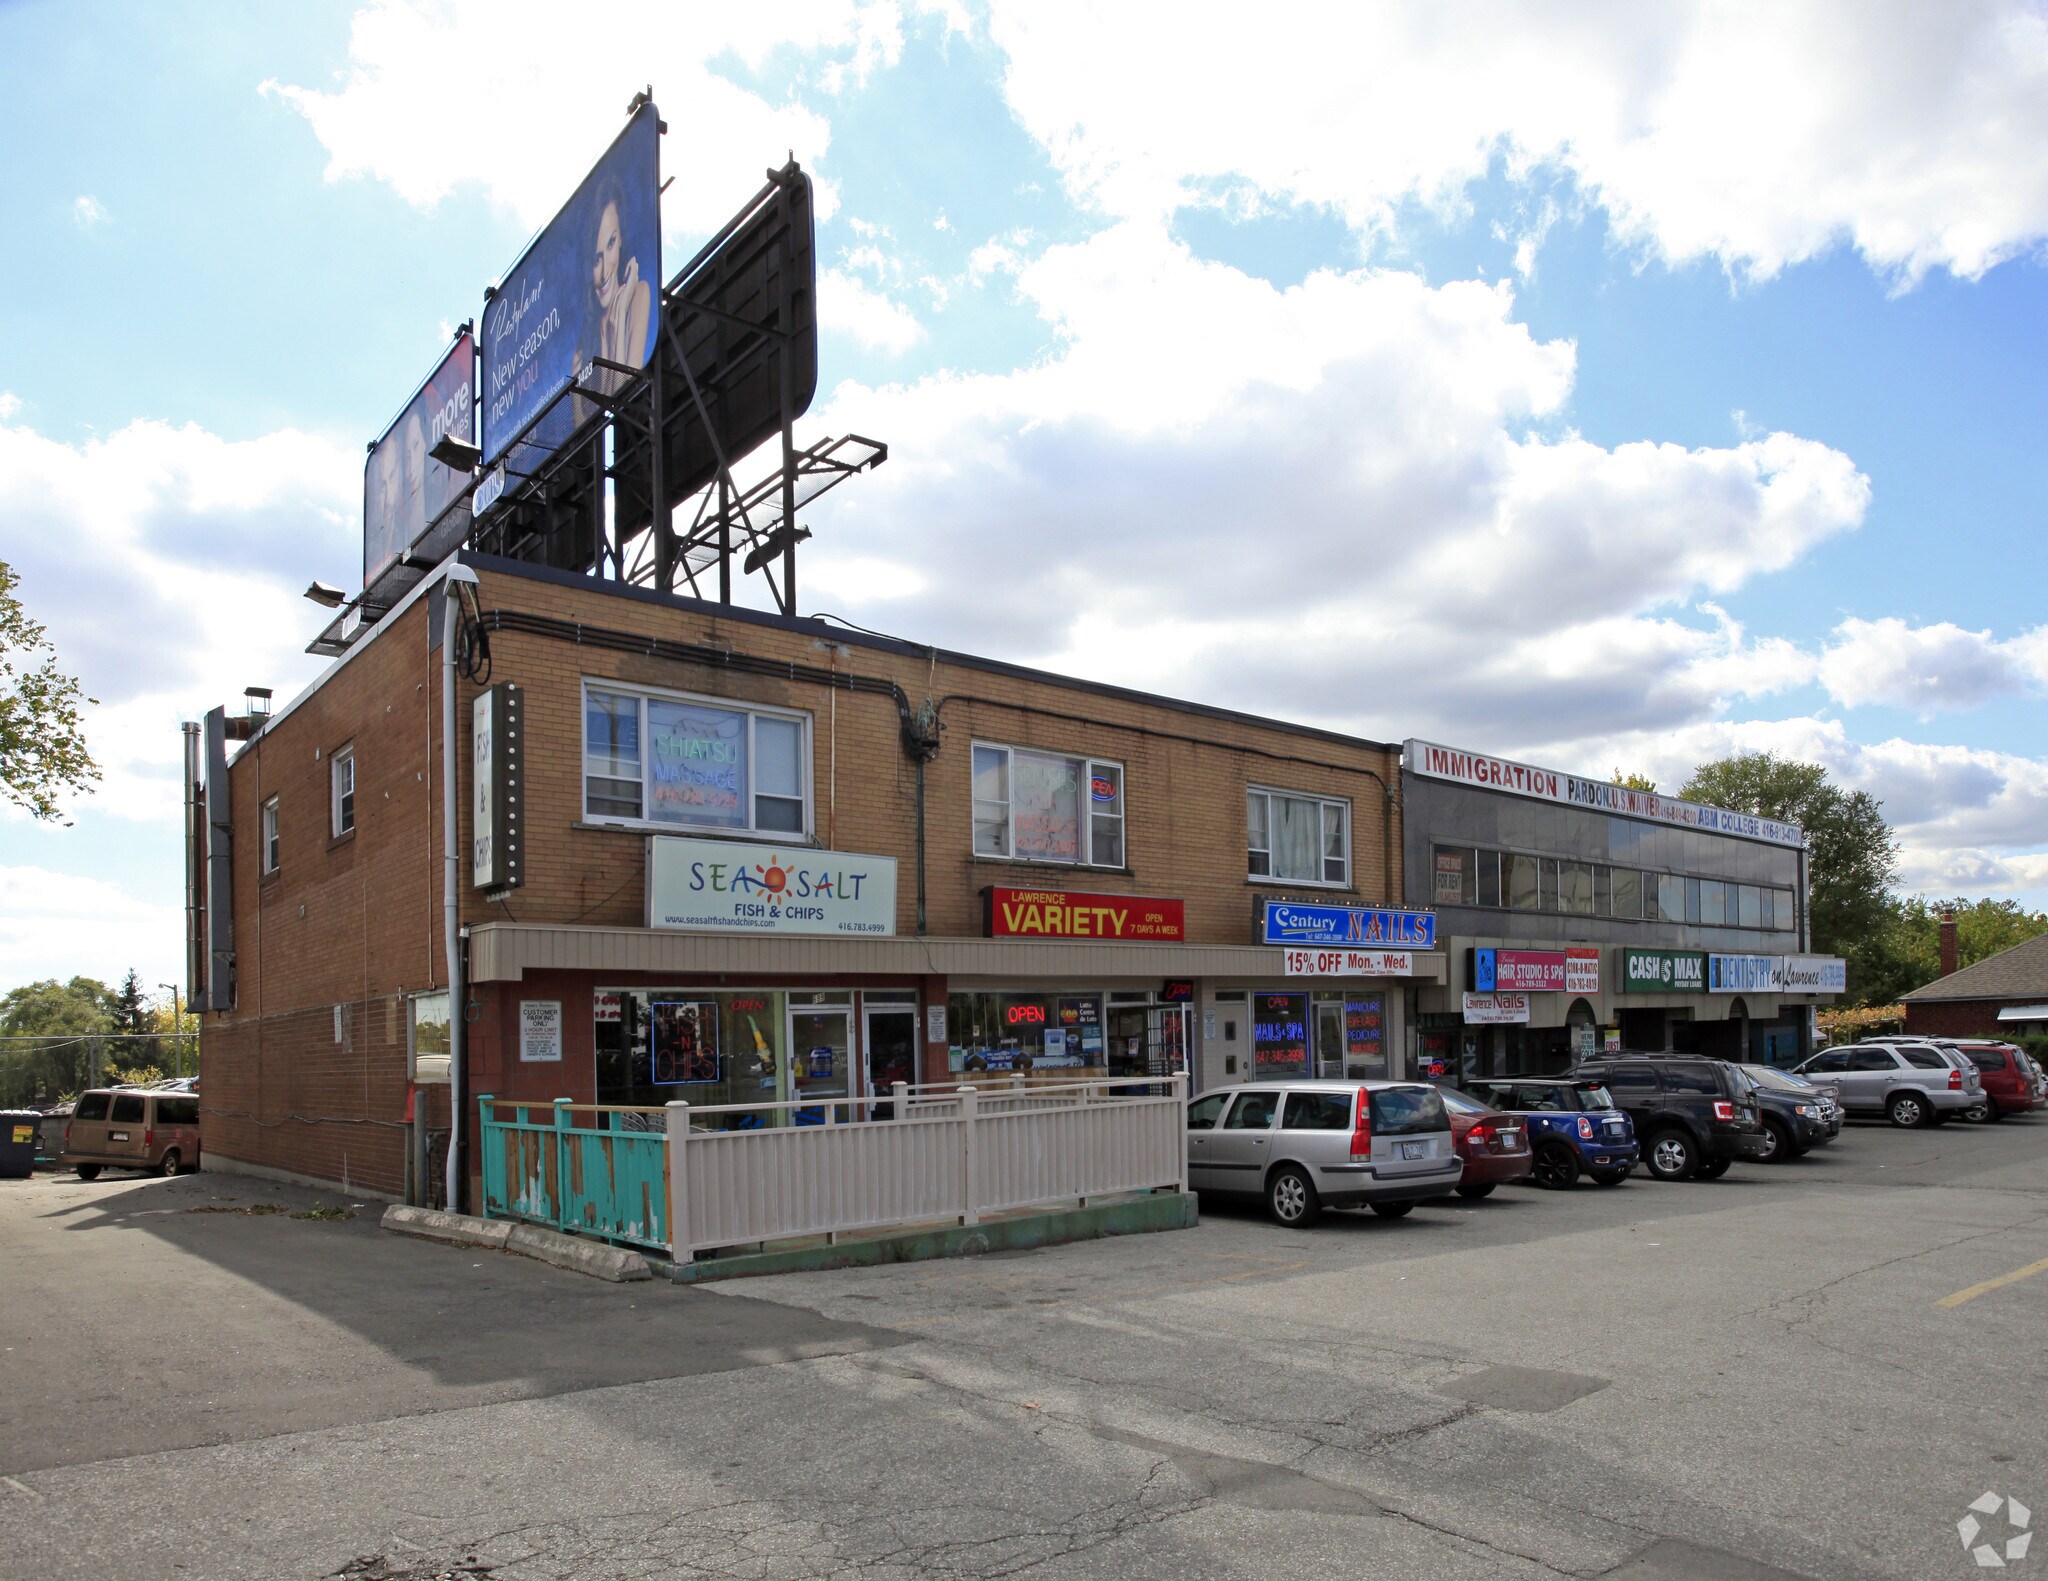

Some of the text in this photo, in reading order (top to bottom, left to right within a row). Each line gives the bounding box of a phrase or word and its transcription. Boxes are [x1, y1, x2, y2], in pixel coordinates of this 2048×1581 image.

[492, 307, 560, 397] New season,
[577, 361, 593, 386] 1423
[492, 360, 539, 425] new you
[432, 382, 469, 442] more
[476, 728, 490, 765] FISH
[656, 734, 737, 764] SHIATSU
[656, 764, 736, 789] MASSAGE
[479, 783, 486, 814] &
[1424, 746, 1557, 797] IMMIGRATION
[1698, 808, 1718, 828] ABM
[1721, 813, 1759, 836] COLLEGE
[475, 836, 492, 870] CHIPS
[689, 861, 867, 900] SEA SALT
[1437, 873, 1461, 890] FOR RENT
[1011, 891, 1066, 904] LAWRENCE
[734, 903, 824, 920] FISH & CHIPS
[1002, 902, 1128, 936] VARIETY
[1145, 913, 1163, 923] OPEN
[665, 916, 885, 932] www.seasaltfishandchips.com 416.783.4999
[1131, 924, 1179, 935] 7 DAYS A WEEK
[1275, 907, 1428, 944] Century NAILS
[1287, 952, 1314, 973] 15%
[1318, 952, 1342, 973] OFF
[1348, 953, 1373, 969] Mon.
[1383, 954, 1408, 969] Wed.
[1497, 963, 1564, 980] HAIR STUDIO & SPA
[1629, 955, 1659, 979] CASH
[1674, 957, 1702, 980] MAX
[1722, 957, 1771, 988] DENTISTRY
[1772, 969, 1782, 985] on
[1783, 963, 1819, 987] Lawrence
[1674, 980, 1689, 988] PAYDAY
[730, 999, 765, 1011] OPEN
[1346, 1001, 1380, 1012] MANICURE
[1465, 993, 1525, 1009] Lawrence Nails
[1008, 1006, 1045, 1023] OPEN
[1255, 1022, 1282, 1042] NAILS
[1286, 1022, 1304, 1041] SPA
[1347, 1029, 1381, 1040] PEDICURE
[1606, 1041, 1619, 1051] FIRST
